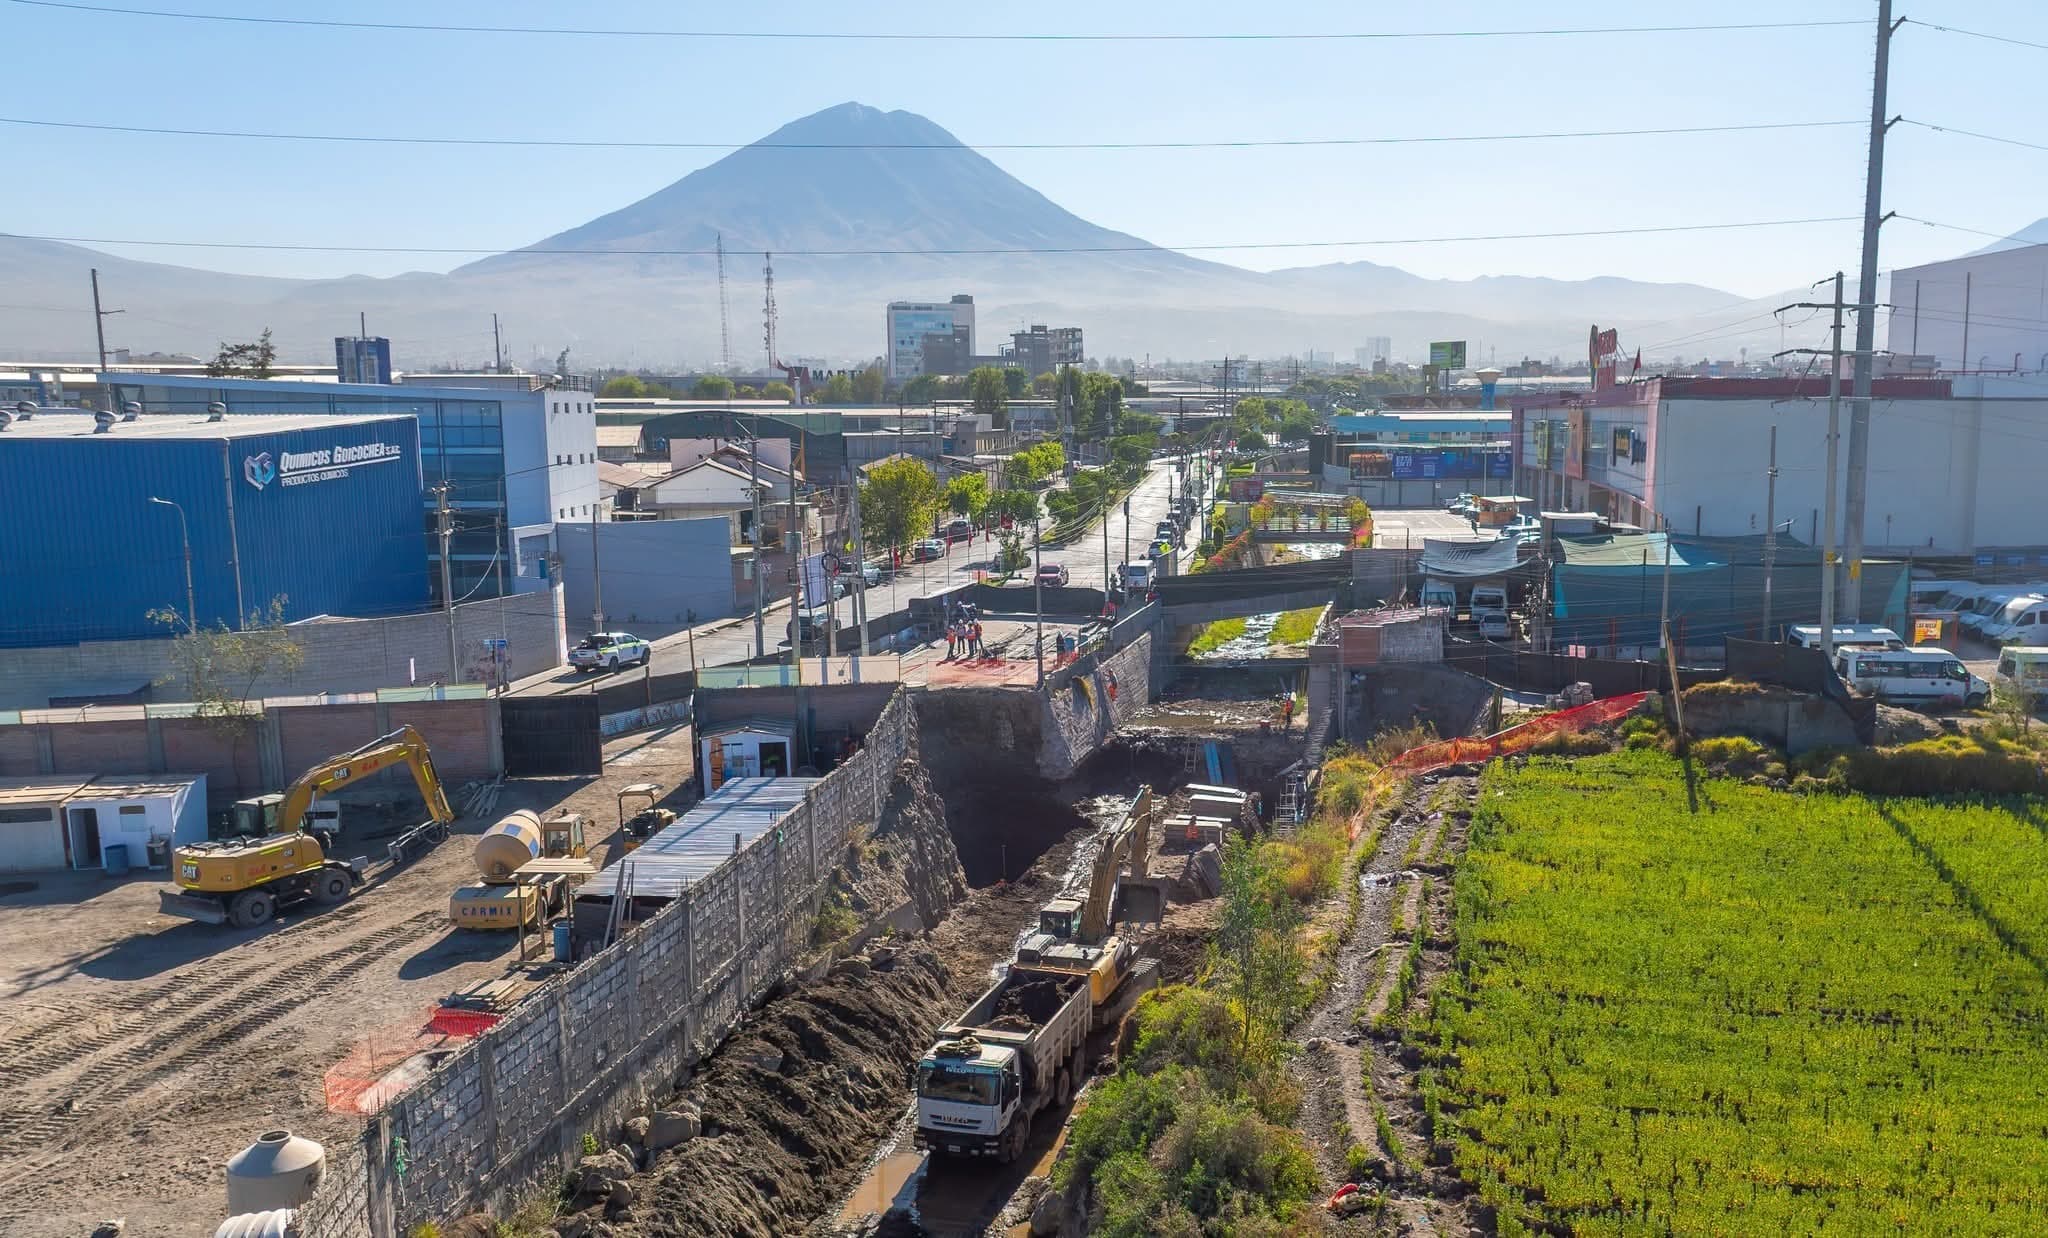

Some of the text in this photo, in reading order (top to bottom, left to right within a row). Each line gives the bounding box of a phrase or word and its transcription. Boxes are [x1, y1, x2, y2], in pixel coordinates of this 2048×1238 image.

[280, 450, 331, 472] QUIMICOS
[333, 443, 385, 464] GOICOCHEA
[281, 472, 320, 487] PRODUCTOS
[334, 768, 348, 780] CAT
[181, 865, 197, 879] CAT
[462, 906, 512, 916] CARMIX
